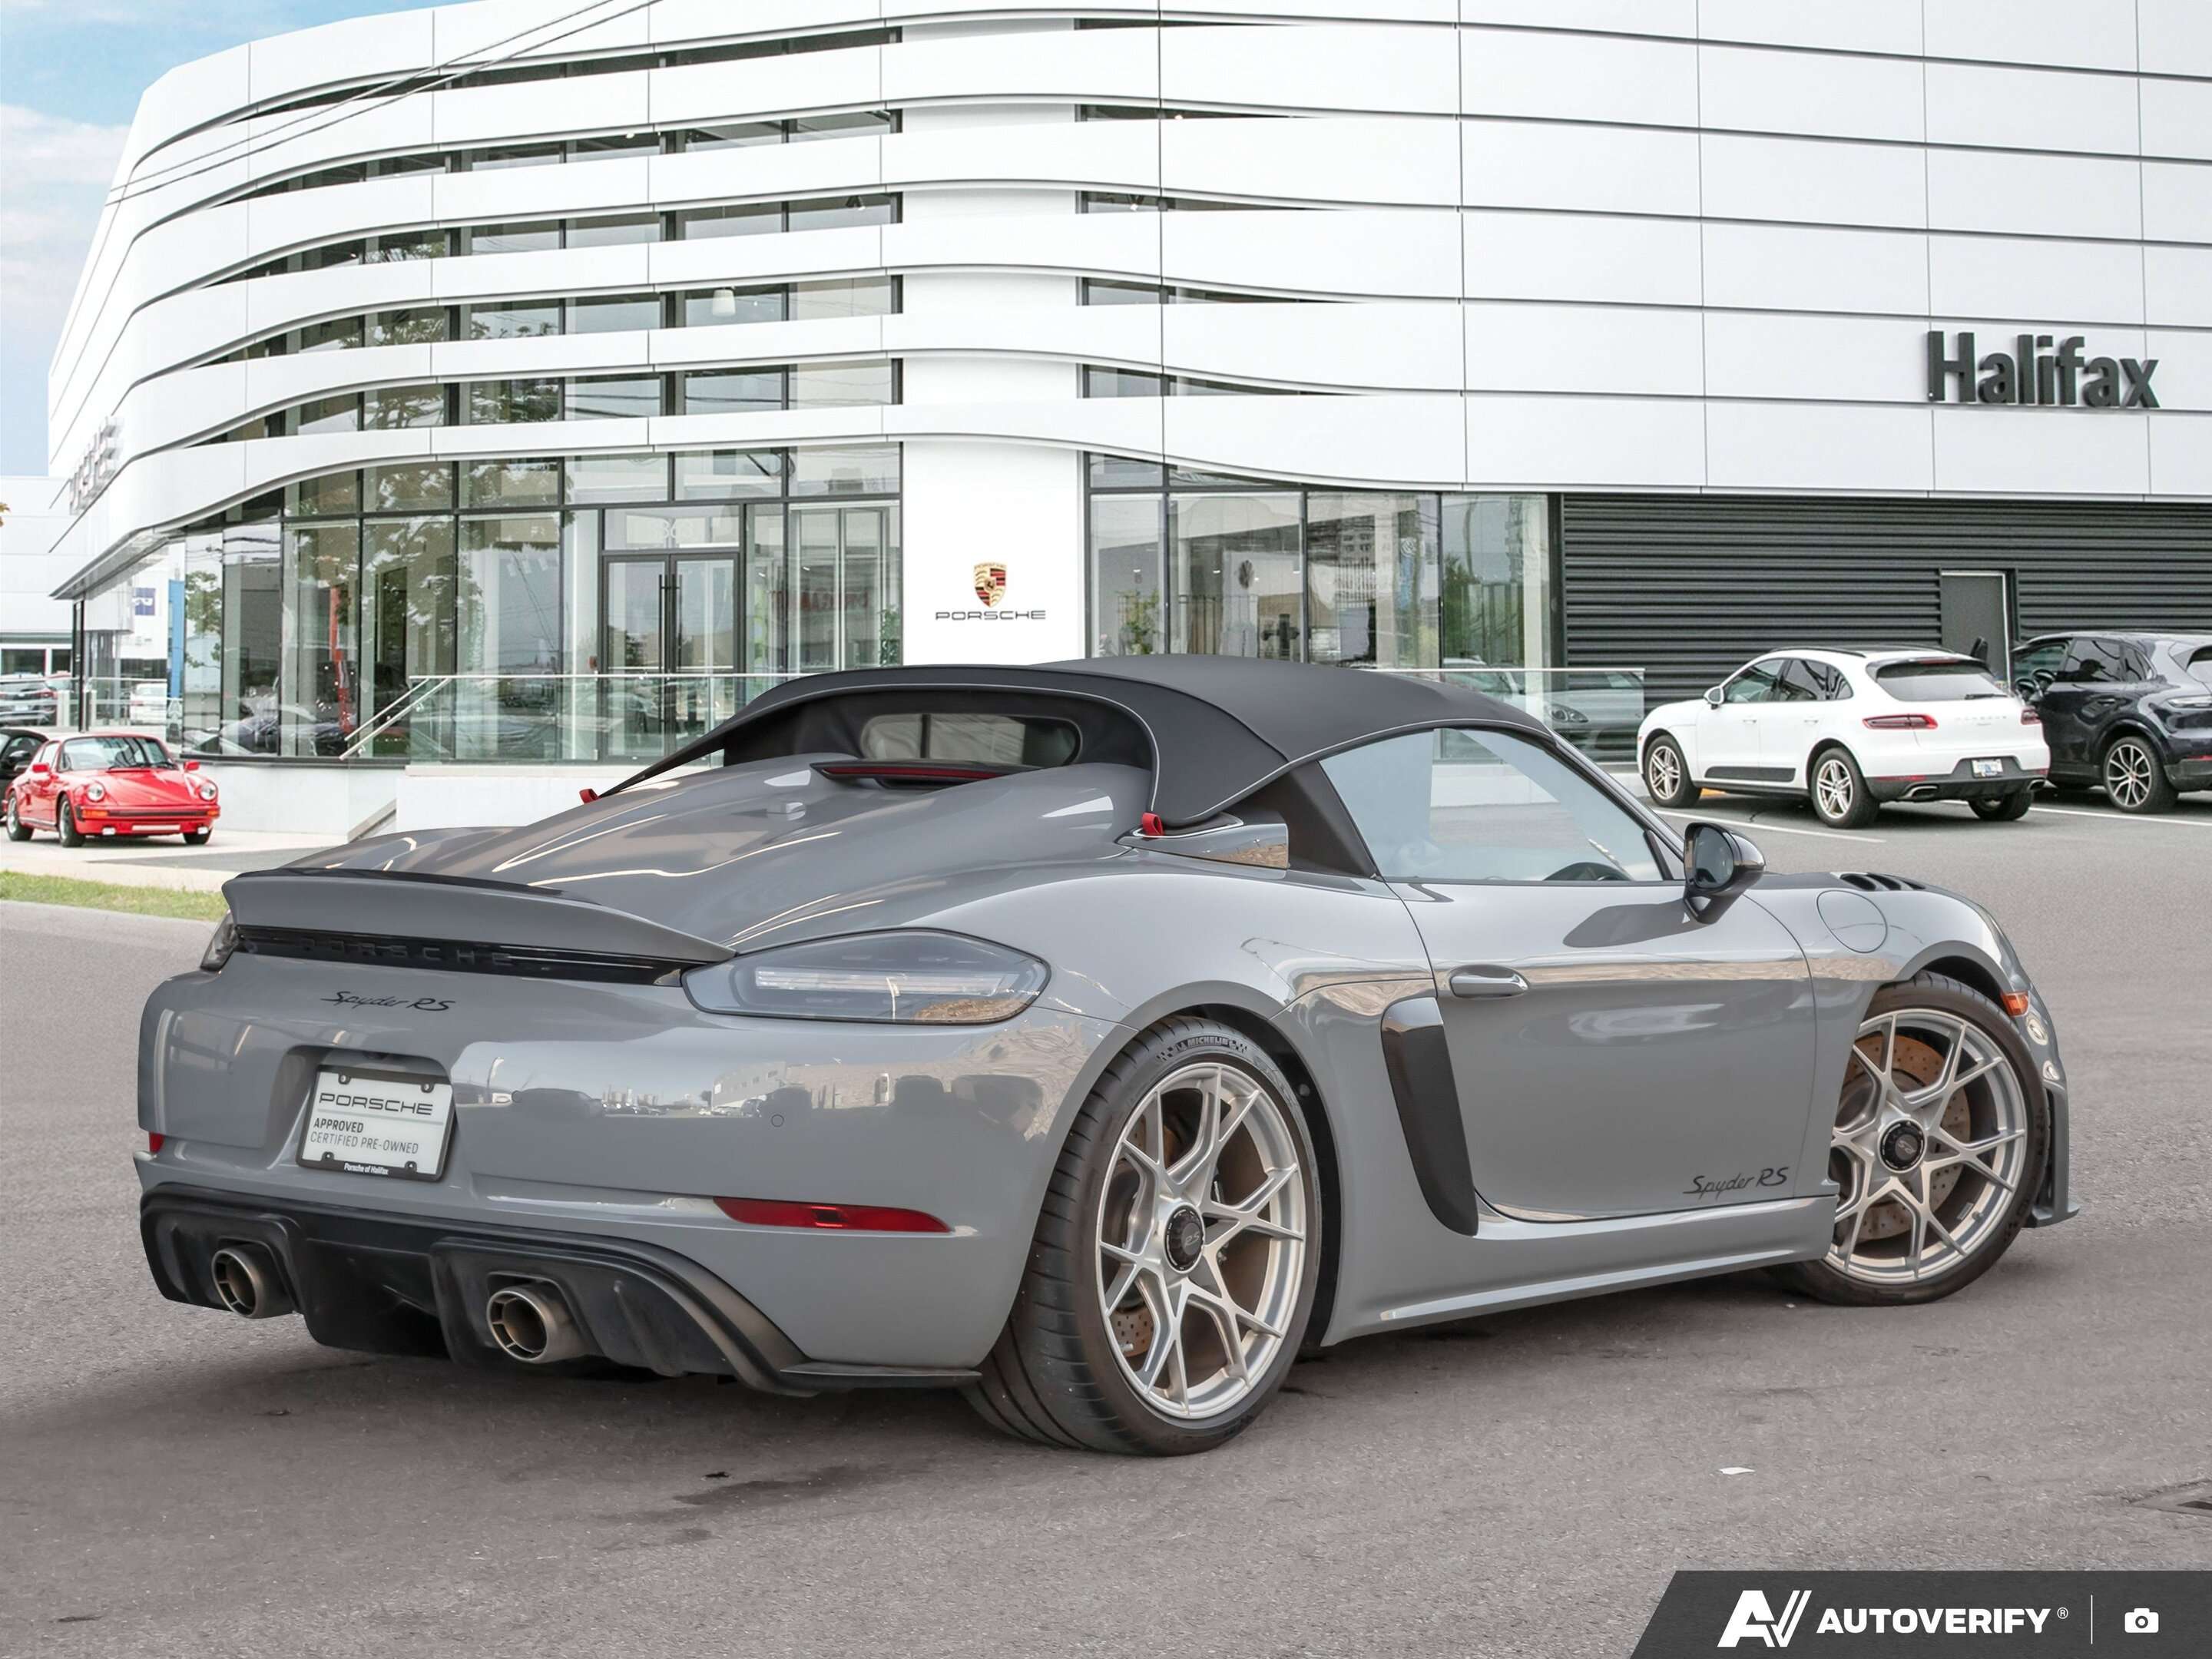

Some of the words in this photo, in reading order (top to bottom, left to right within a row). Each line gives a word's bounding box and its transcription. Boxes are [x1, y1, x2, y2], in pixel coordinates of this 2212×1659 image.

[1926, 331, 2161, 408] Halifax
[935, 611, 1046, 621] PORSCHE
[320, 991, 409, 1008] Spyder
[406, 998, 456, 1012] RS
[1187, 1035, 1230, 1048] MICHELIN
[319, 1092, 433, 1116] PORSCHE
[313, 1118, 364, 1134] APPROVED
[310, 1131, 359, 1147] CERTIFIED
[360, 1137, 419, 1154] PRE-OWNED
[344, 1162, 364, 1173] Porsche
[1683, 1173, 1755, 1200] Spyder
[1756, 1167, 1789, 1187] RS
[1184, 1231, 1200, 1247] RS
